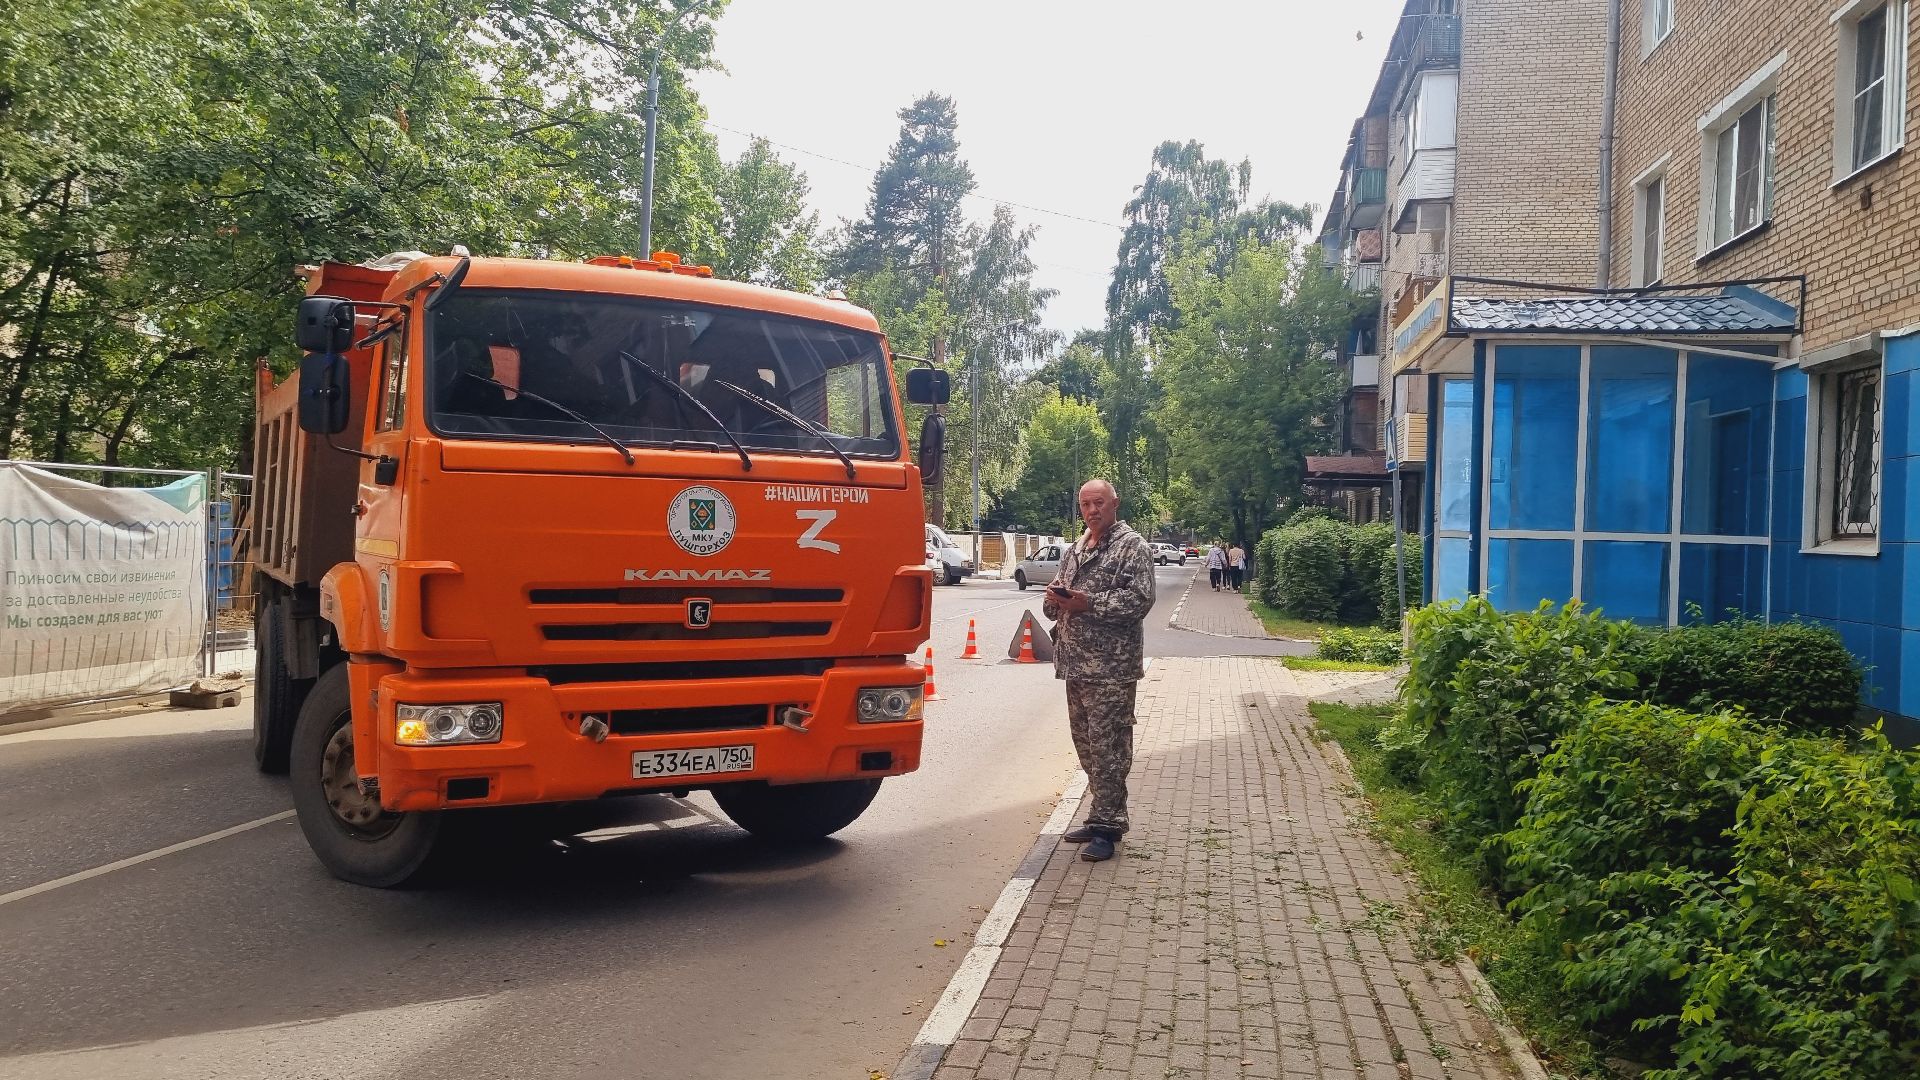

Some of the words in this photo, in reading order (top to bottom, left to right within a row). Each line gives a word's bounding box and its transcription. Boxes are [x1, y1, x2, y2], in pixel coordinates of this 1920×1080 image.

[674, 529, 731, 553] ПУШГОРХОЗ
[692, 533, 714, 542] МКУ
[795, 509, 841, 555] Z
[6, 570, 81, 589] Приносим
[86, 573, 117, 584] свои
[120, 570, 176, 583] извинения
[623, 568, 772, 582] KAMAZ
[5, 596, 23, 607] за
[27, 593, 125, 609] доставленные
[128, 587, 182, 605] неудобства
[7, 614, 32, 629] Мы
[36, 614, 94, 629] создаем
[97, 612, 121, 627] для
[123, 611, 142, 622] вас
[144, 609, 164, 624] уют
[721, 747, 749, 764] 750
[726, 762, 741, 770] RUS
